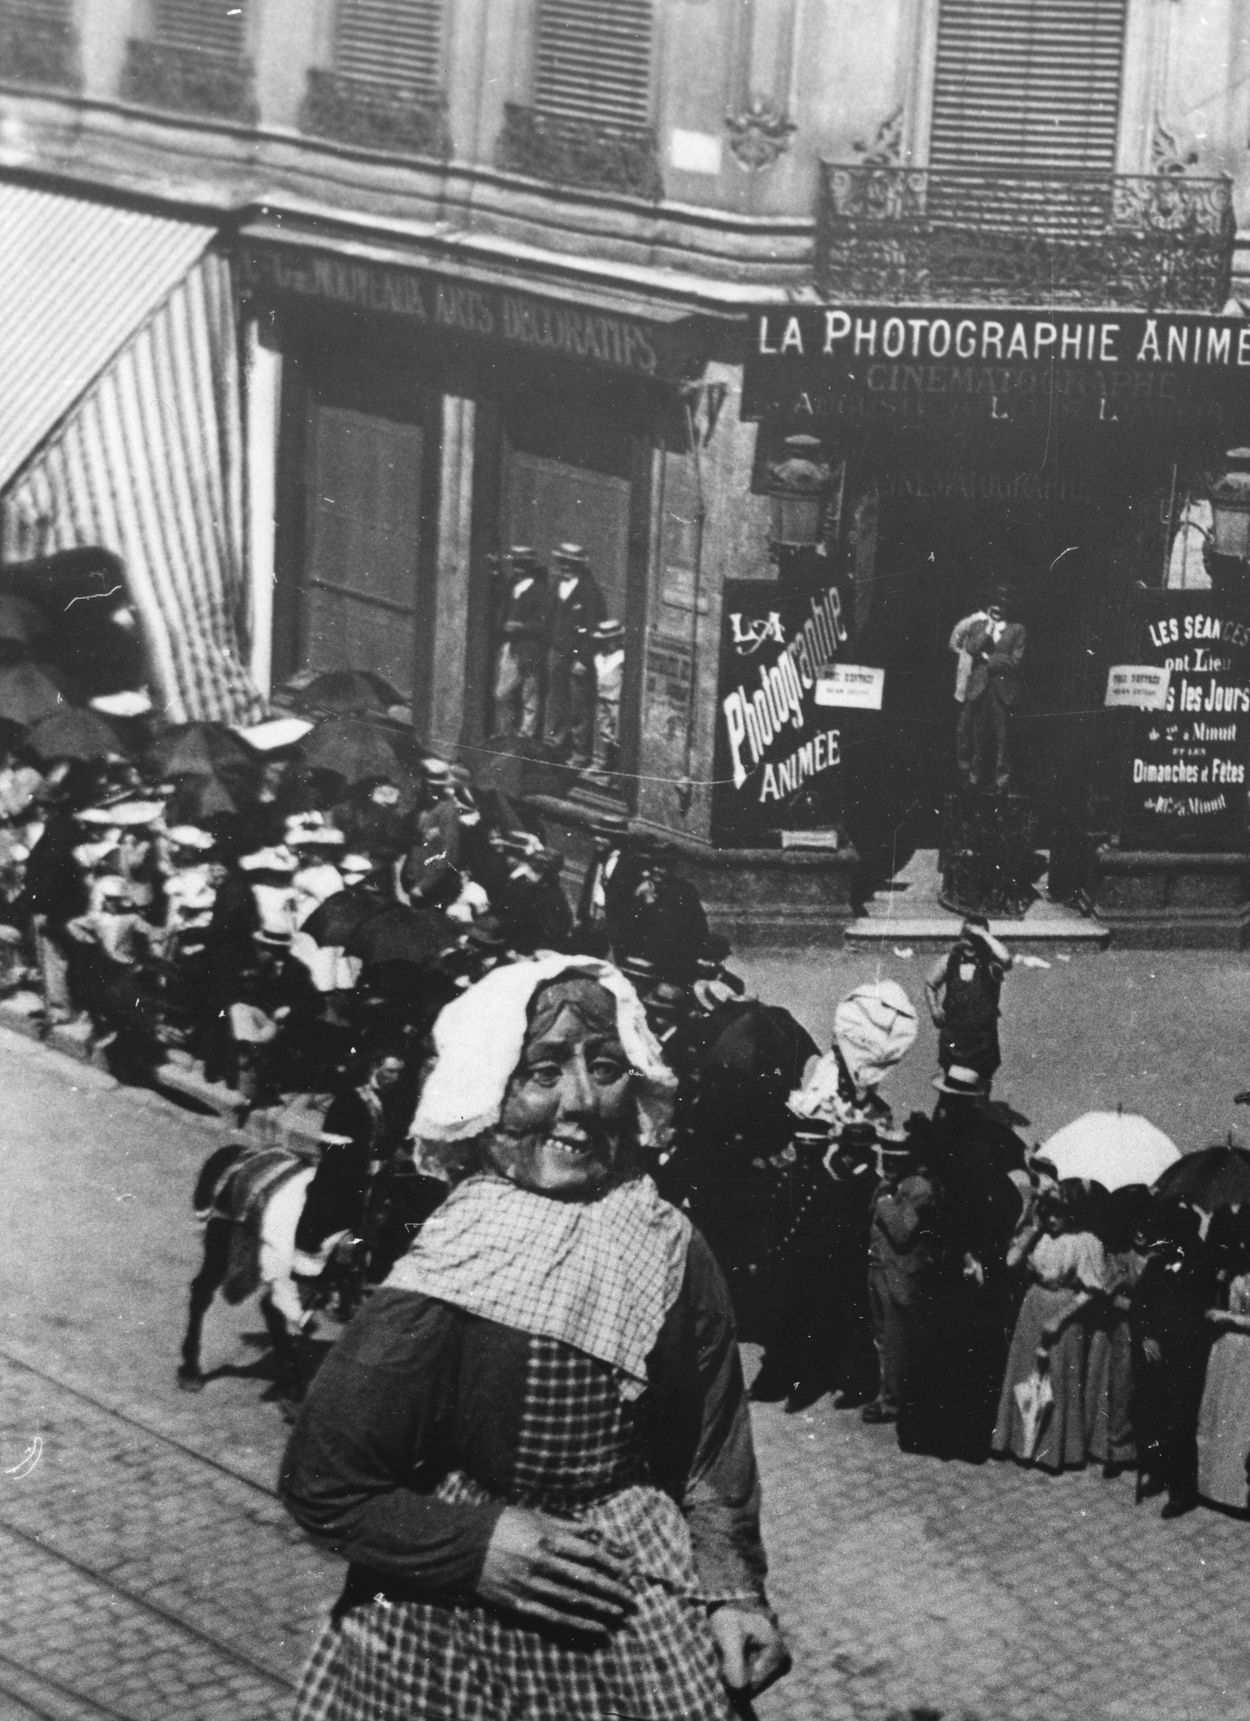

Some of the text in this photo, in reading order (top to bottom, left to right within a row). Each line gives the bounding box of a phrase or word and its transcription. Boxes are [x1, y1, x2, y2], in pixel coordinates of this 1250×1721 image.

[435, 282, 495, 336] ARTS
[758, 317, 803, 356] LA
[823, 310, 1121, 362] PHOTOGRAPHIE
[1148, 617, 1180, 648] LES
[1164, 654, 1191, 672] ont
[1180, 678, 1203, 712] les
[1204, 678, 1250, 712] Jours
[1133, 758, 1198, 784] Dimanches
